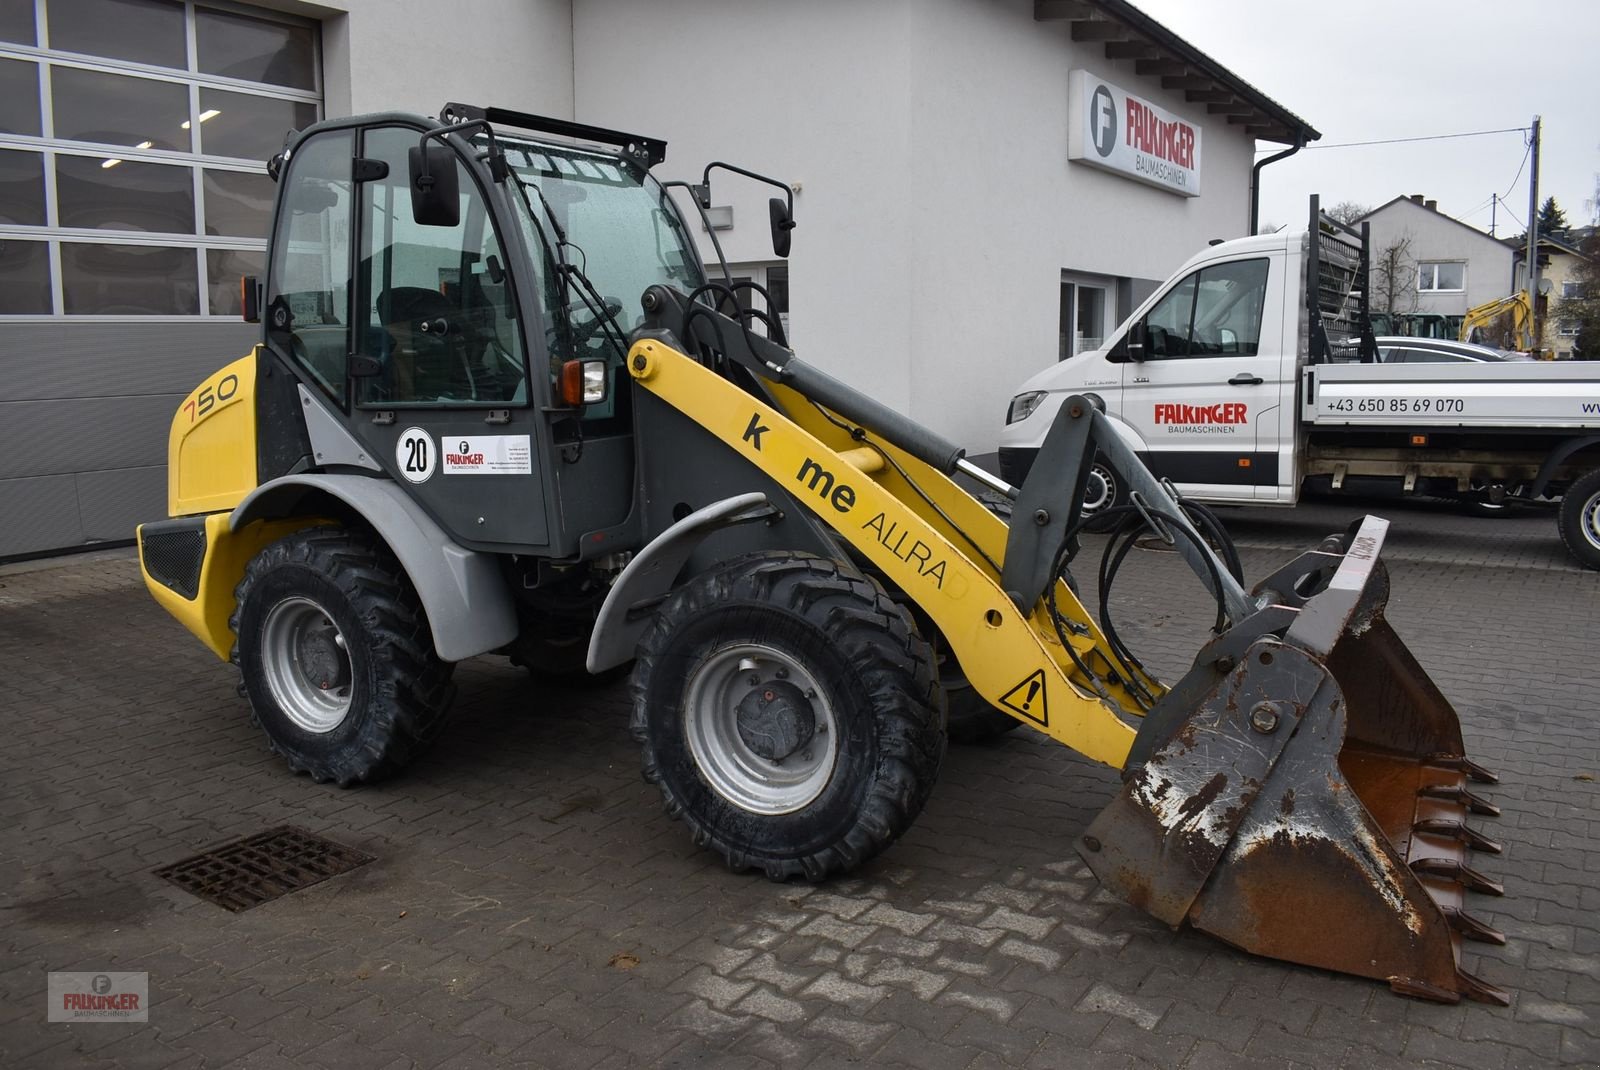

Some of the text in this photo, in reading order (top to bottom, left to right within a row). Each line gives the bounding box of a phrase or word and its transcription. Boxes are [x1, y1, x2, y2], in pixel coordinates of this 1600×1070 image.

[1125, 96, 1195, 171] FALKINGER
[1135, 155, 1187, 186] BAUMASCHINEN
[183, 374, 238, 423] 750
[1327, 399, 1464, 412] +43 650 85 69 070
[1154, 403, 1248, 424] FALKINGER
[1168, 426, 1235, 434] BAUMASCHINEN
[405, 437, 428, 472] 20
[446, 453, 484, 465] FALKINGER
